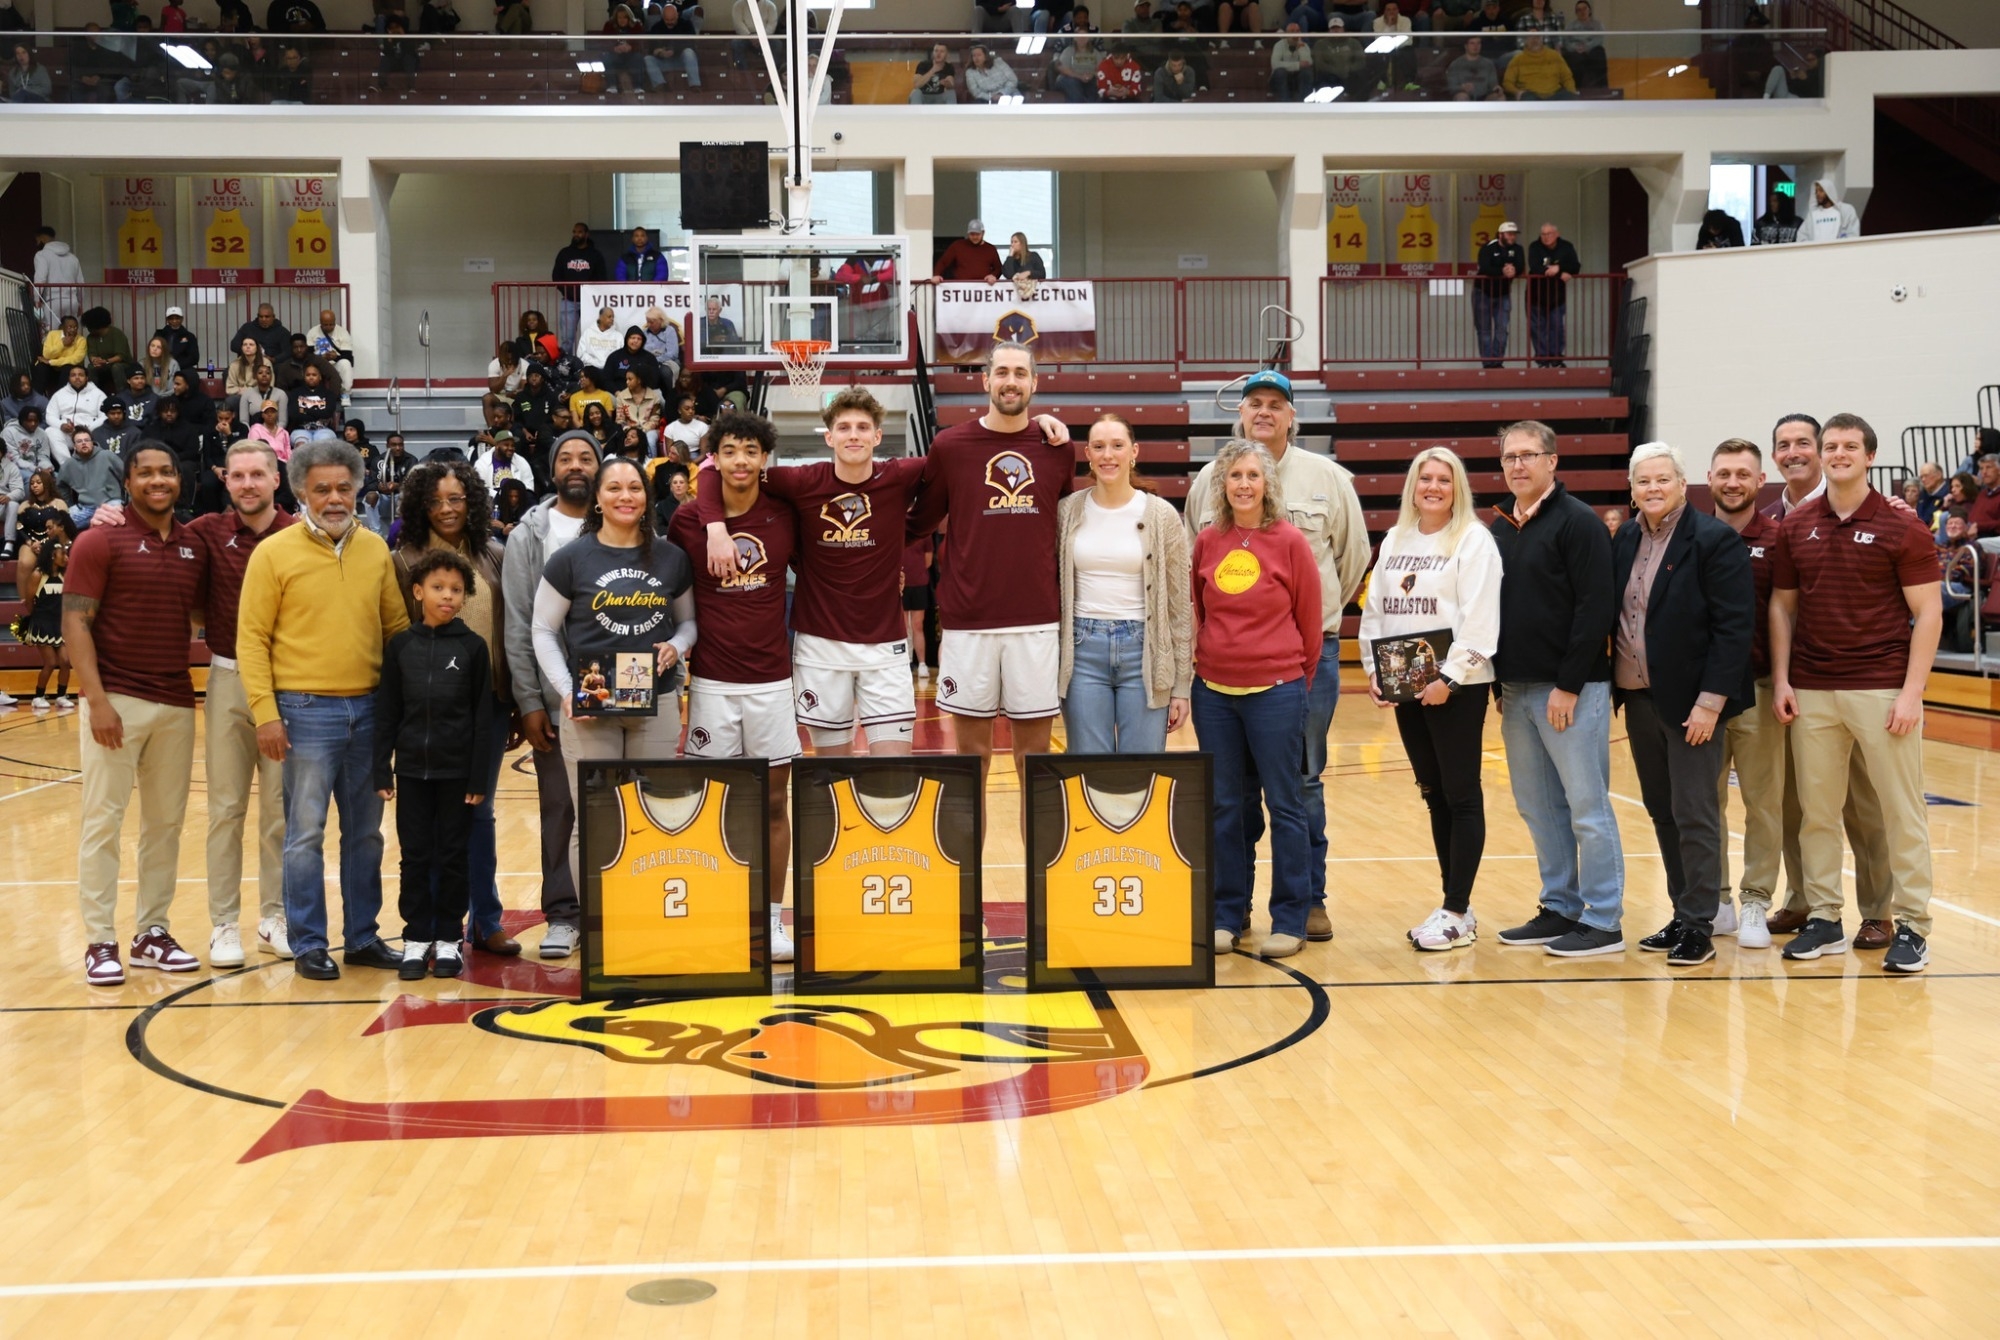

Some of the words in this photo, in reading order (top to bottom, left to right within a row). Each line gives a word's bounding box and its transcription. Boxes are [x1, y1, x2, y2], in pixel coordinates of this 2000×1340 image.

[126, 178, 154, 195] UC
[213, 178, 241, 195] UC
[296, 179, 323, 195] UC
[1334, 175, 1360, 191] UC
[1405, 175, 1431, 191] UC
[1479, 174, 1505, 190] UC
[126, 237, 158, 254] 14
[211, 236, 245, 253] 32
[296, 237, 327, 254] 10
[1333, 232, 1363, 249] 14
[1401, 232, 1434, 248] 23
[127, 276, 156, 284] TYLER
[128, 269, 155, 277] KEITH
[219, 269, 238, 277] LISA
[220, 276, 237, 284] LEE
[294, 276, 327, 284] GAINES
[295, 269, 325, 277] AJAMU
[592, 294, 656, 308] VISITOR
[942, 289, 1014, 302] STUDENT
[1021, 288, 1087, 302] ECTION
[1853, 531, 1875, 544] UC
[179, 546, 195, 559] UC
[595, 567, 649, 588] UNIVERSITY
[647, 577, 663, 588] OF
[591, 590, 668, 611] Charleston
[595, 612, 630, 635] GOLDEN
[633, 611, 664, 635] EAGLES
[1467, 656, 1479, 667] 22
[631, 848, 720, 876] CHARLESTON
[843, 845, 932, 873] CHARLESTON
[1074, 846, 1162, 873] CHARLESTON
[663, 877, 689, 919] 2
[861, 874, 913, 915] 22
[1093, 876, 1144, 917] 33
